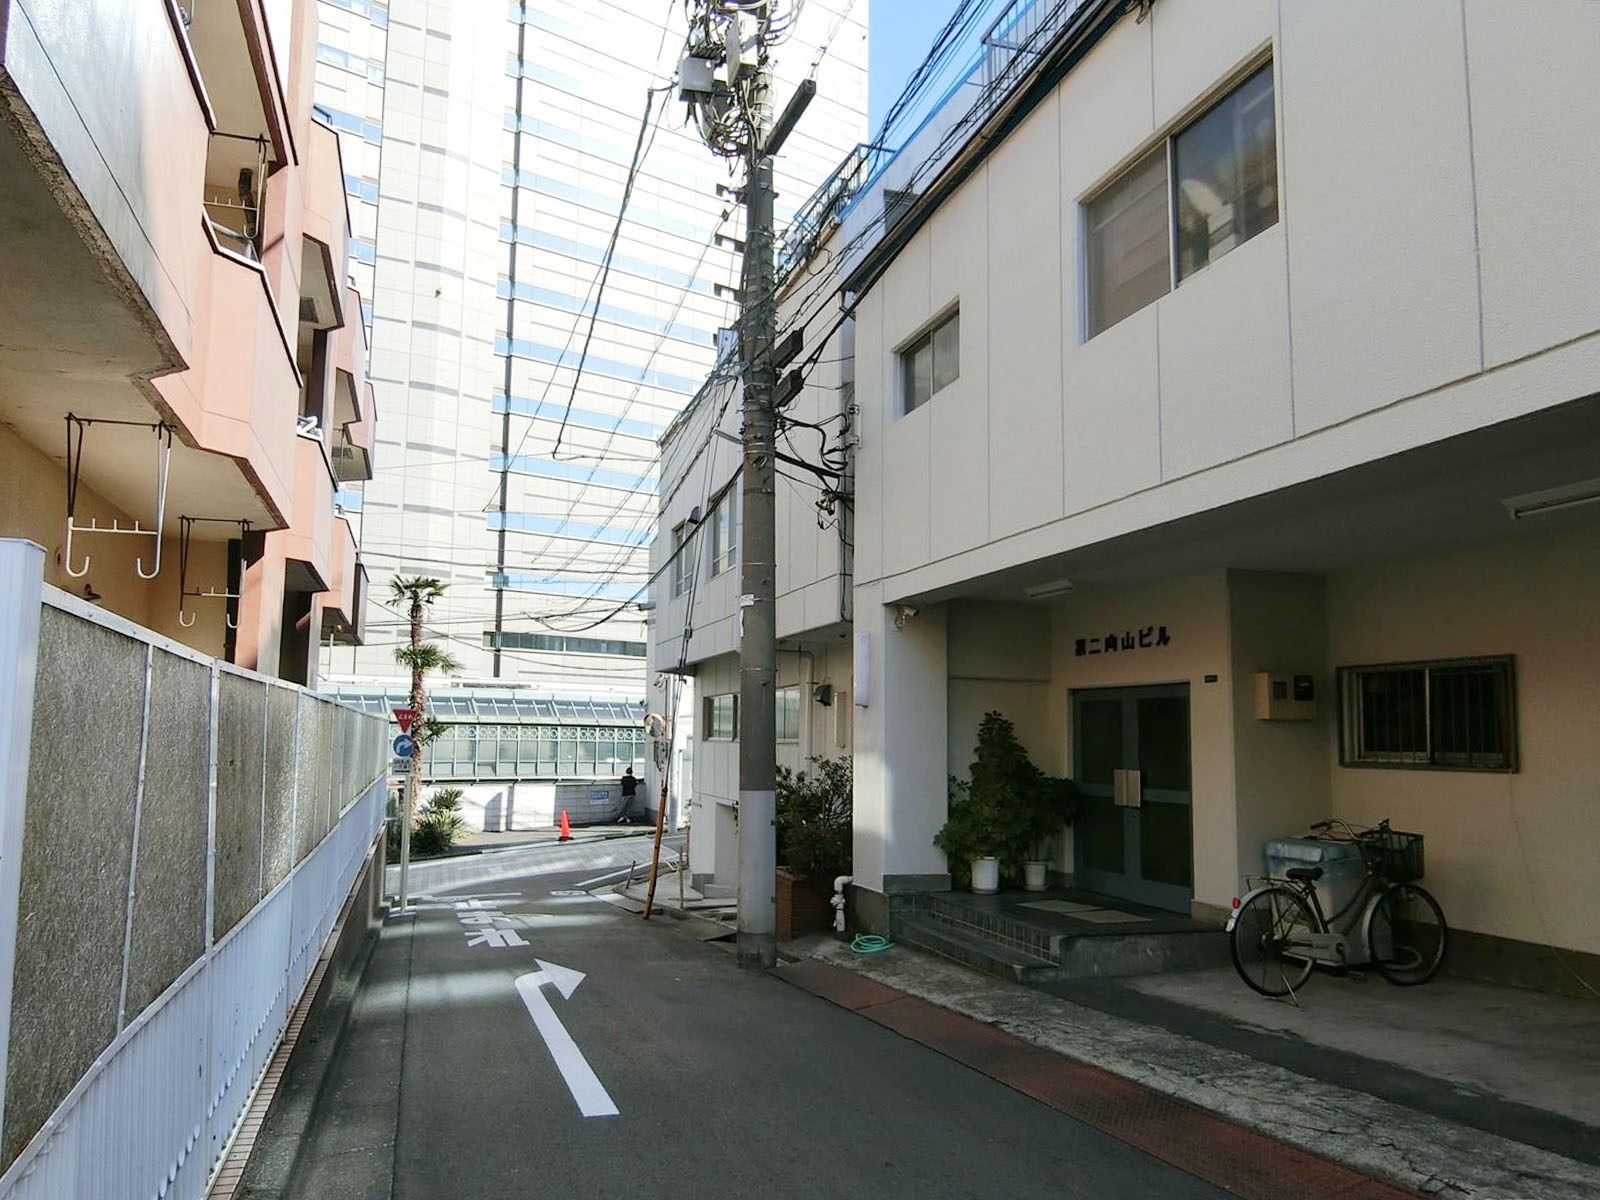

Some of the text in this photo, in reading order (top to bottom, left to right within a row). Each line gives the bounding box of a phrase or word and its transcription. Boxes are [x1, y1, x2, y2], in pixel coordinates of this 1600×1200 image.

[1075, 626, 1170, 656] 第二向山ビル
[453, 899, 531, 948] 止まれ
